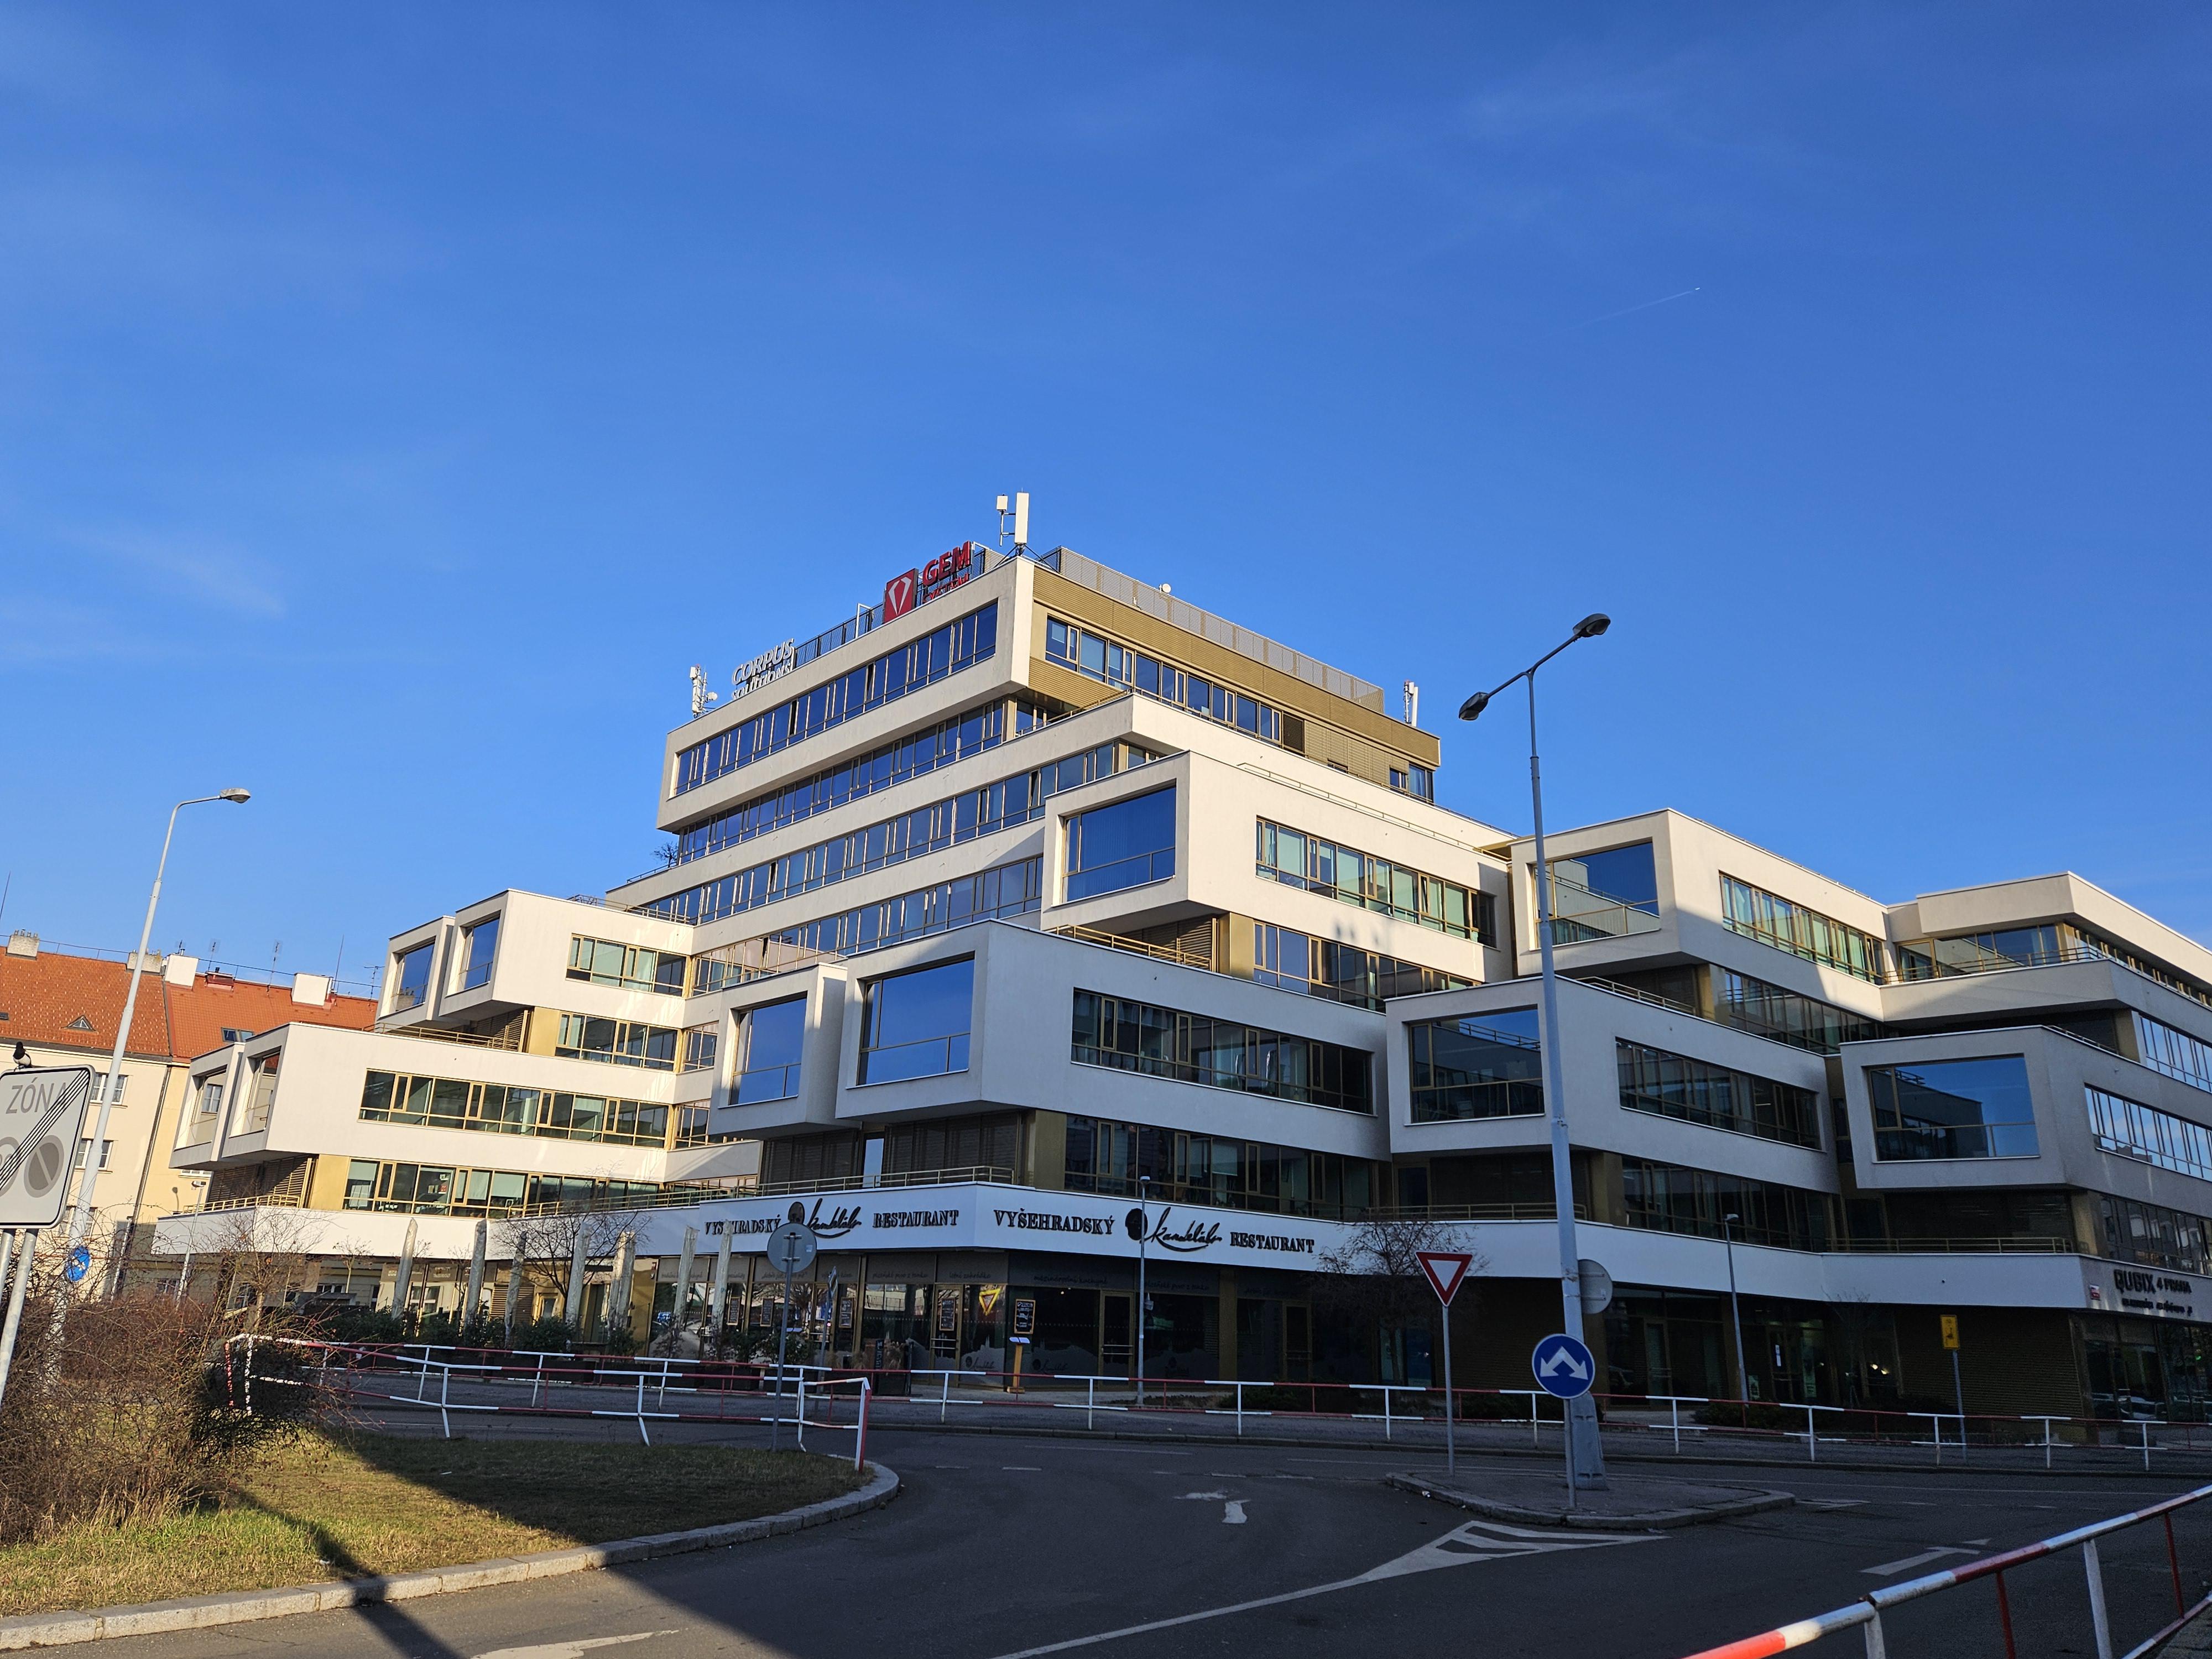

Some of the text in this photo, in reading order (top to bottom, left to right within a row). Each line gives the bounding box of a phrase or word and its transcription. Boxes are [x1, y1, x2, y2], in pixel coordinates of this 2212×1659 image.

[922, 540, 971, 586] GEM
[732, 638, 795, 686] CORPUS
[732, 662, 791, 700] SOLUTIONS
[872, 1209, 959, 1228] RESTAURANT
[993, 1208, 1115, 1235] VYŠEHRADSKÝ
[1230, 1232, 1314, 1253] RESTAURANT
